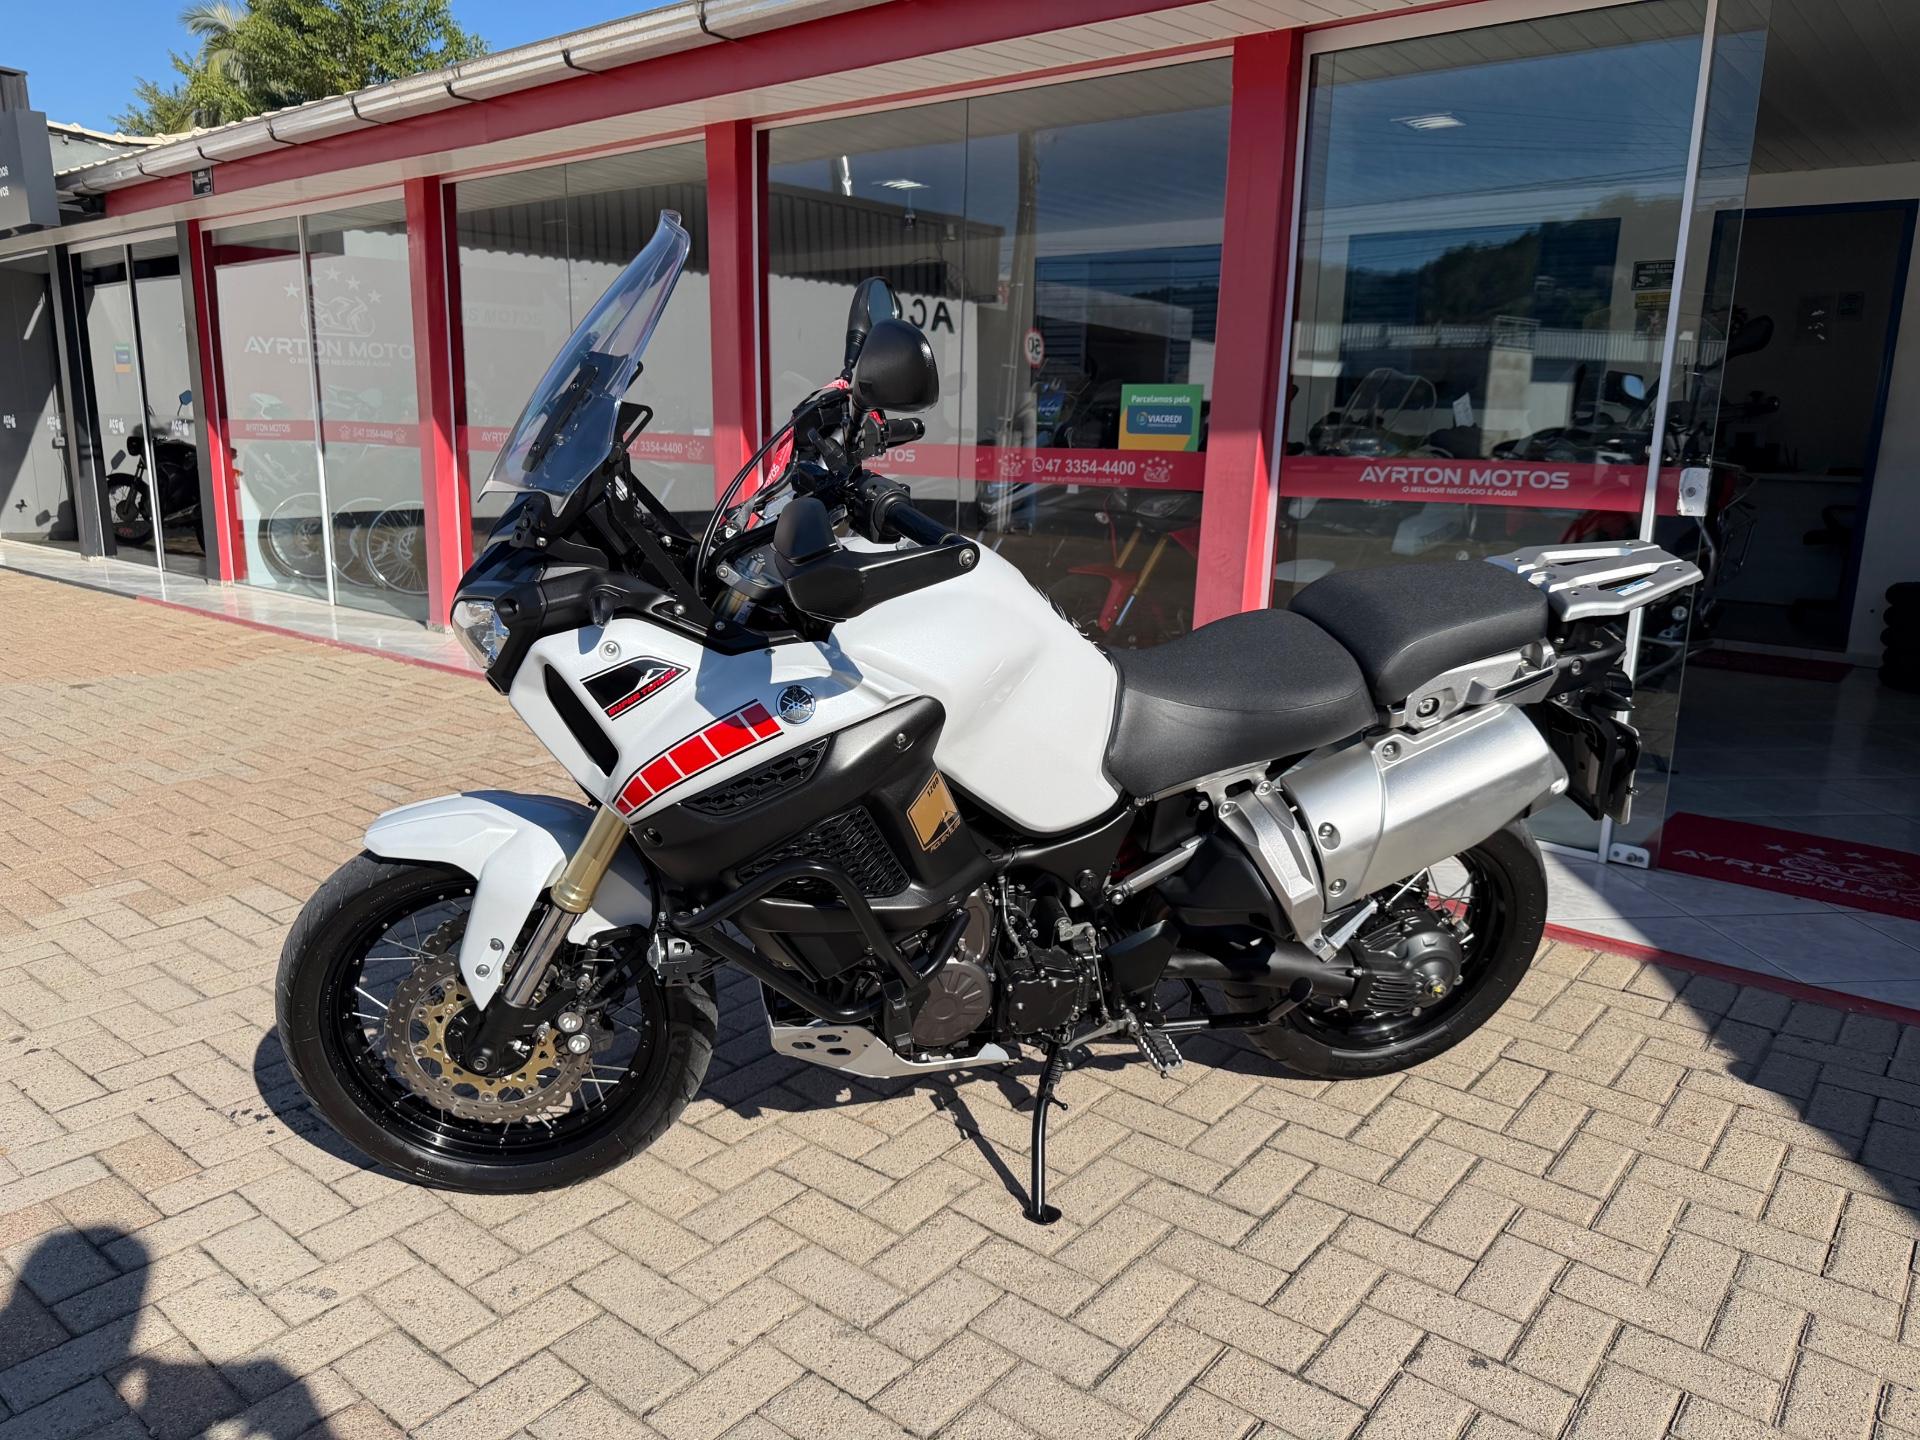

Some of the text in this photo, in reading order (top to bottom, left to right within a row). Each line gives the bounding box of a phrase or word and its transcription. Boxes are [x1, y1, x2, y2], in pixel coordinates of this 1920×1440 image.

[244, 336, 414, 360] AYRTON MOTO
[1131, 395, 1191, 404] Parcelamos pela
[1148, 415, 1182, 424] VIACREDI
[640, 442, 683, 454] 3354-4400
[868, 449, 916, 462] OTOS
[1046, 458, 1136, 475] 47 3354-4400
[1359, 466, 1570, 489] AYRTON MOTOS
[1411, 486, 1445, 494] MELHOR
[1494, 488, 1518, 497] AQUI
[1672, 849, 1845, 888] AYRTON
